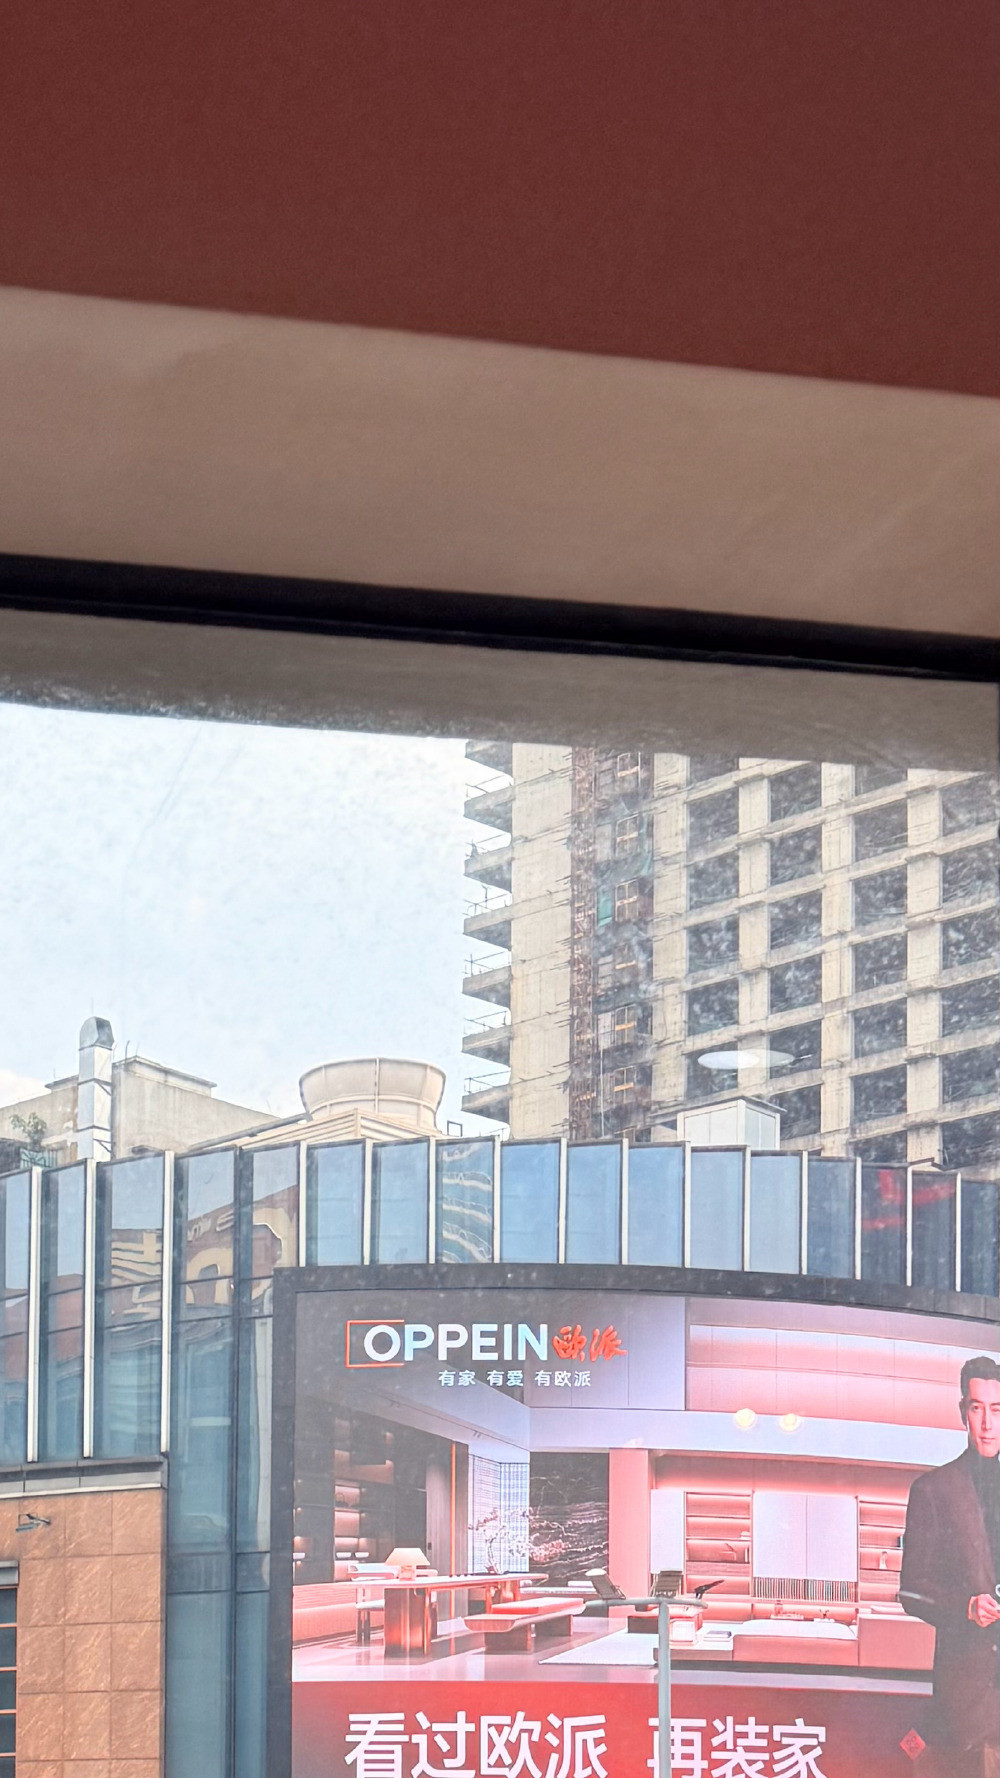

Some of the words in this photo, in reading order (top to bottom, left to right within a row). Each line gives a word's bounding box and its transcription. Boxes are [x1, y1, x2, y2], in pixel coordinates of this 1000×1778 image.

[364, 1324, 547, 1361] OPPEIN
[438, 1370, 476, 1387] 有家
[487, 1370, 524, 1387] 有爱
[535, 1370, 591, 1387] 有欧派
